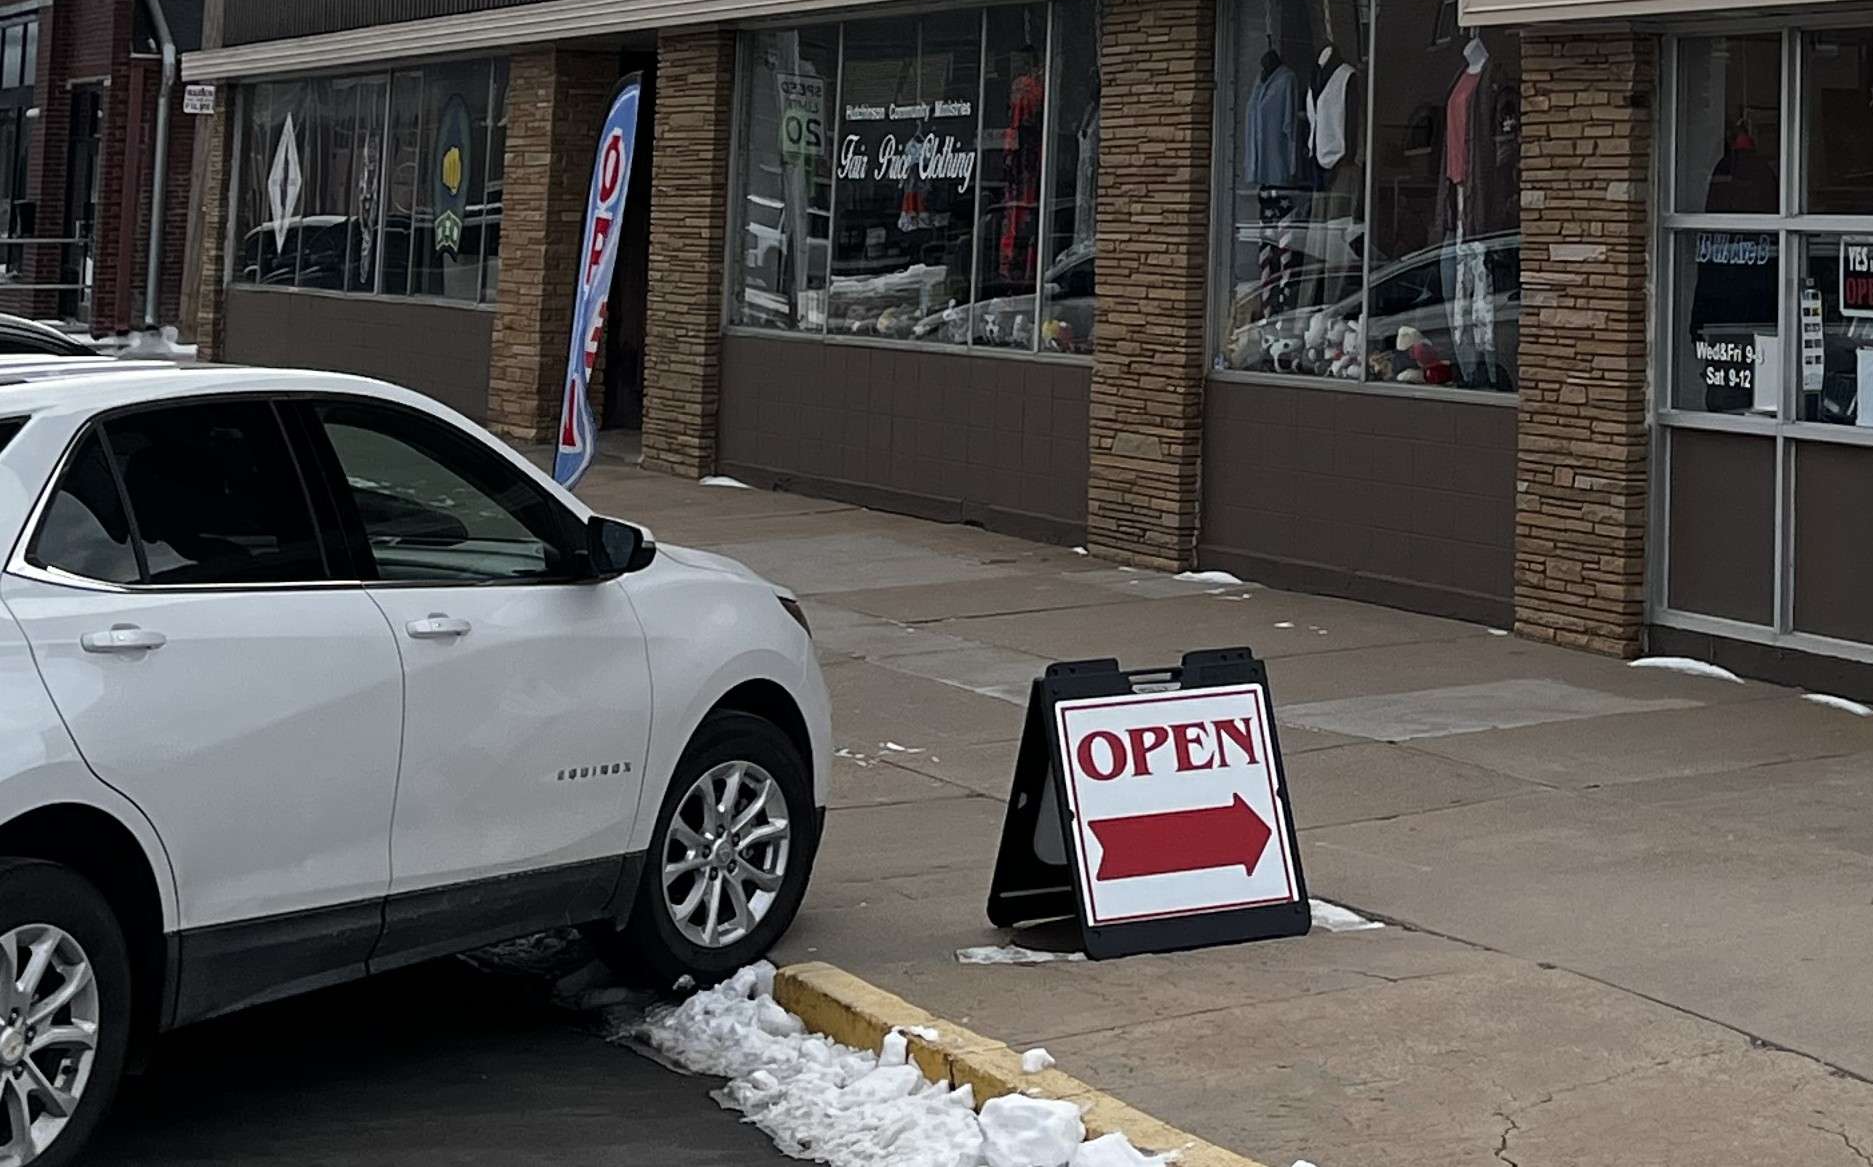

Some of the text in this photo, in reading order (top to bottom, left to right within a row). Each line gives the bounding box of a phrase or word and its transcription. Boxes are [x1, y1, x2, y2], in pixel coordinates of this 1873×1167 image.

[846, 99, 971, 122] Hutchinson Community Ministries
[838, 133, 975, 193] Fair Price Clothing
[1848, 246, 1868, 271] YES
[1696, 341, 1742, 363] Wed&Fri
[1706, 366, 1751, 388] Sat 9-12
[1076, 717, 1259, 781] OPEN
